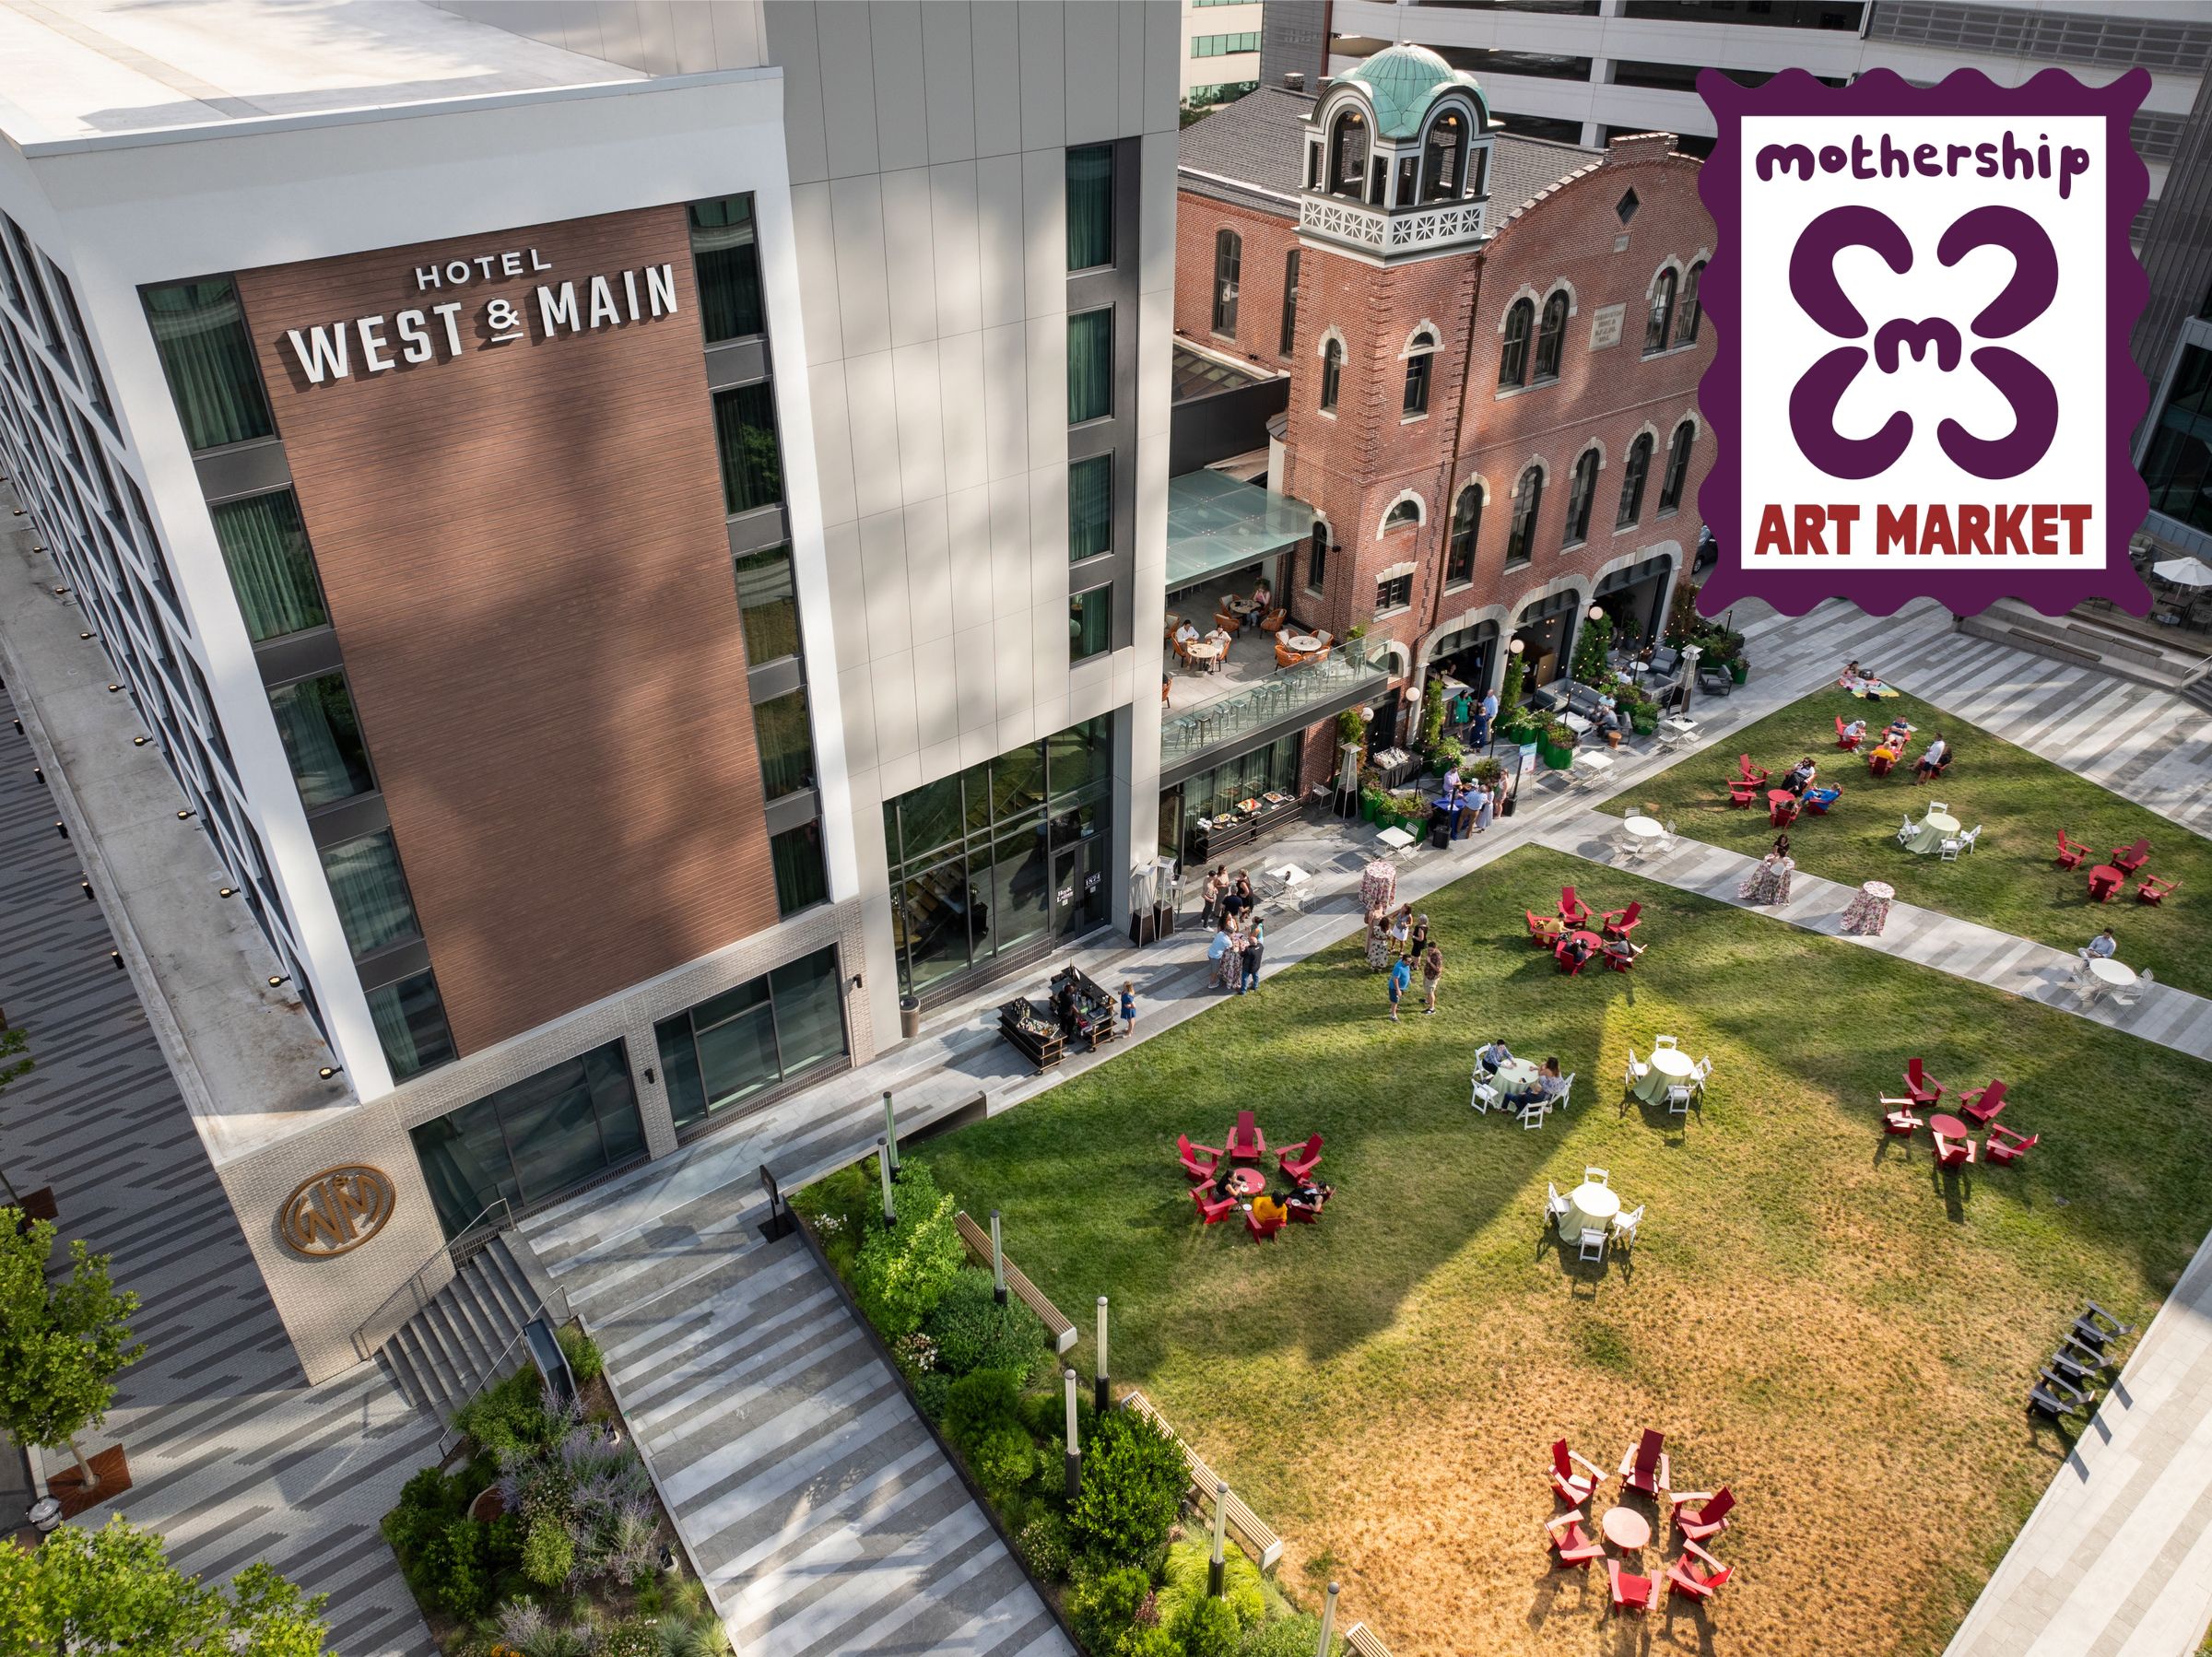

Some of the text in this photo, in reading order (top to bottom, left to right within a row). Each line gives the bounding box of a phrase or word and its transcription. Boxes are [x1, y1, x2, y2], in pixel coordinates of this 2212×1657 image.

[417, 248, 552, 290] HOTEL
[288, 264, 678, 383] WEST & MAIN
